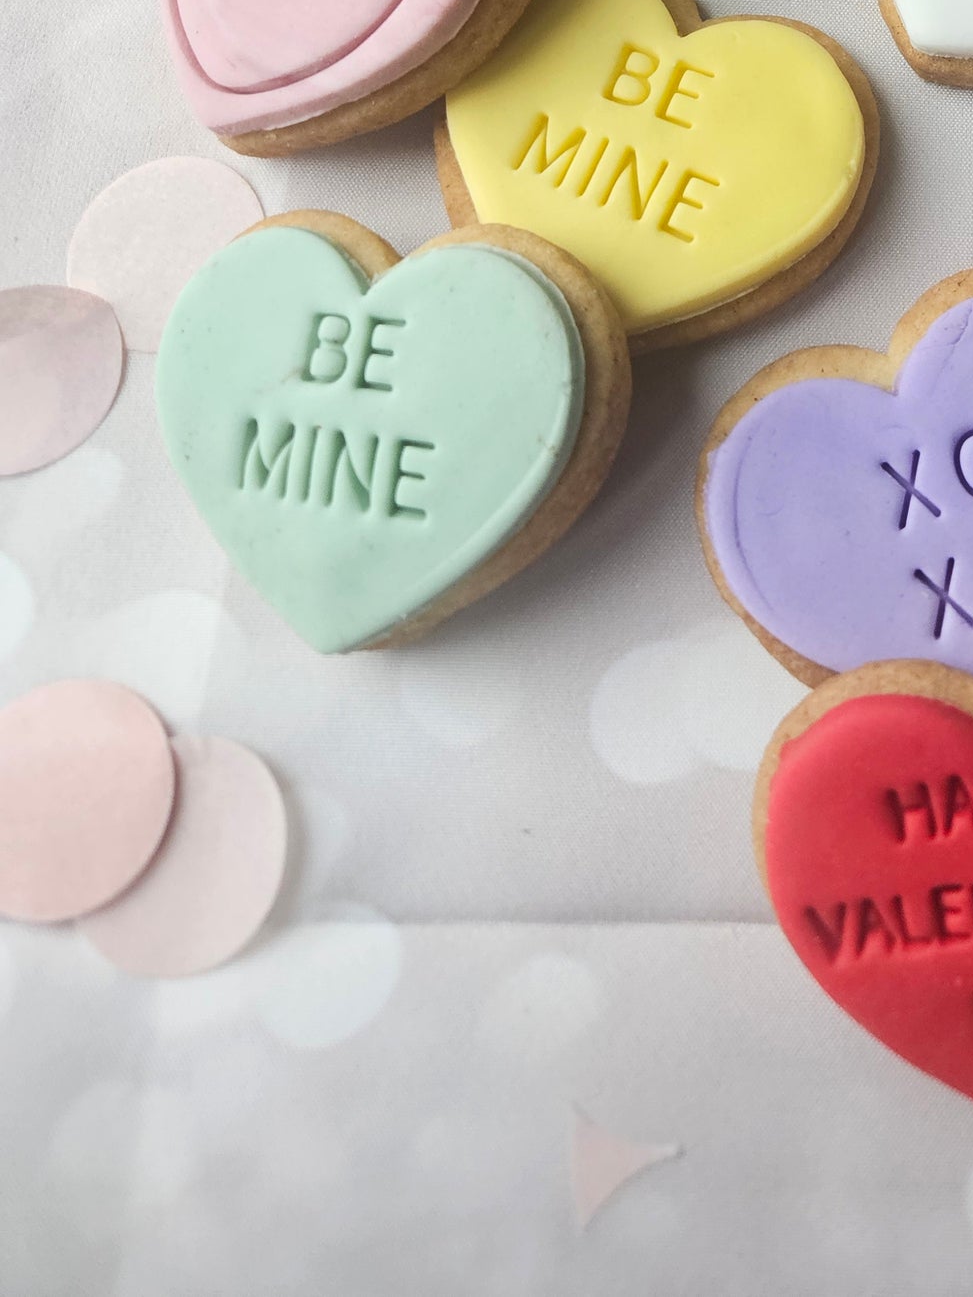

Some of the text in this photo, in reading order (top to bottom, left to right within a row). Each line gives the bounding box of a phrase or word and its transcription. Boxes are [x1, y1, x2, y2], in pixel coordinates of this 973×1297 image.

[602, 42, 715, 129] BE
[512, 112, 720, 243] MINE
[301, 312, 406, 392] BE
[239, 417, 435, 520] MINE
